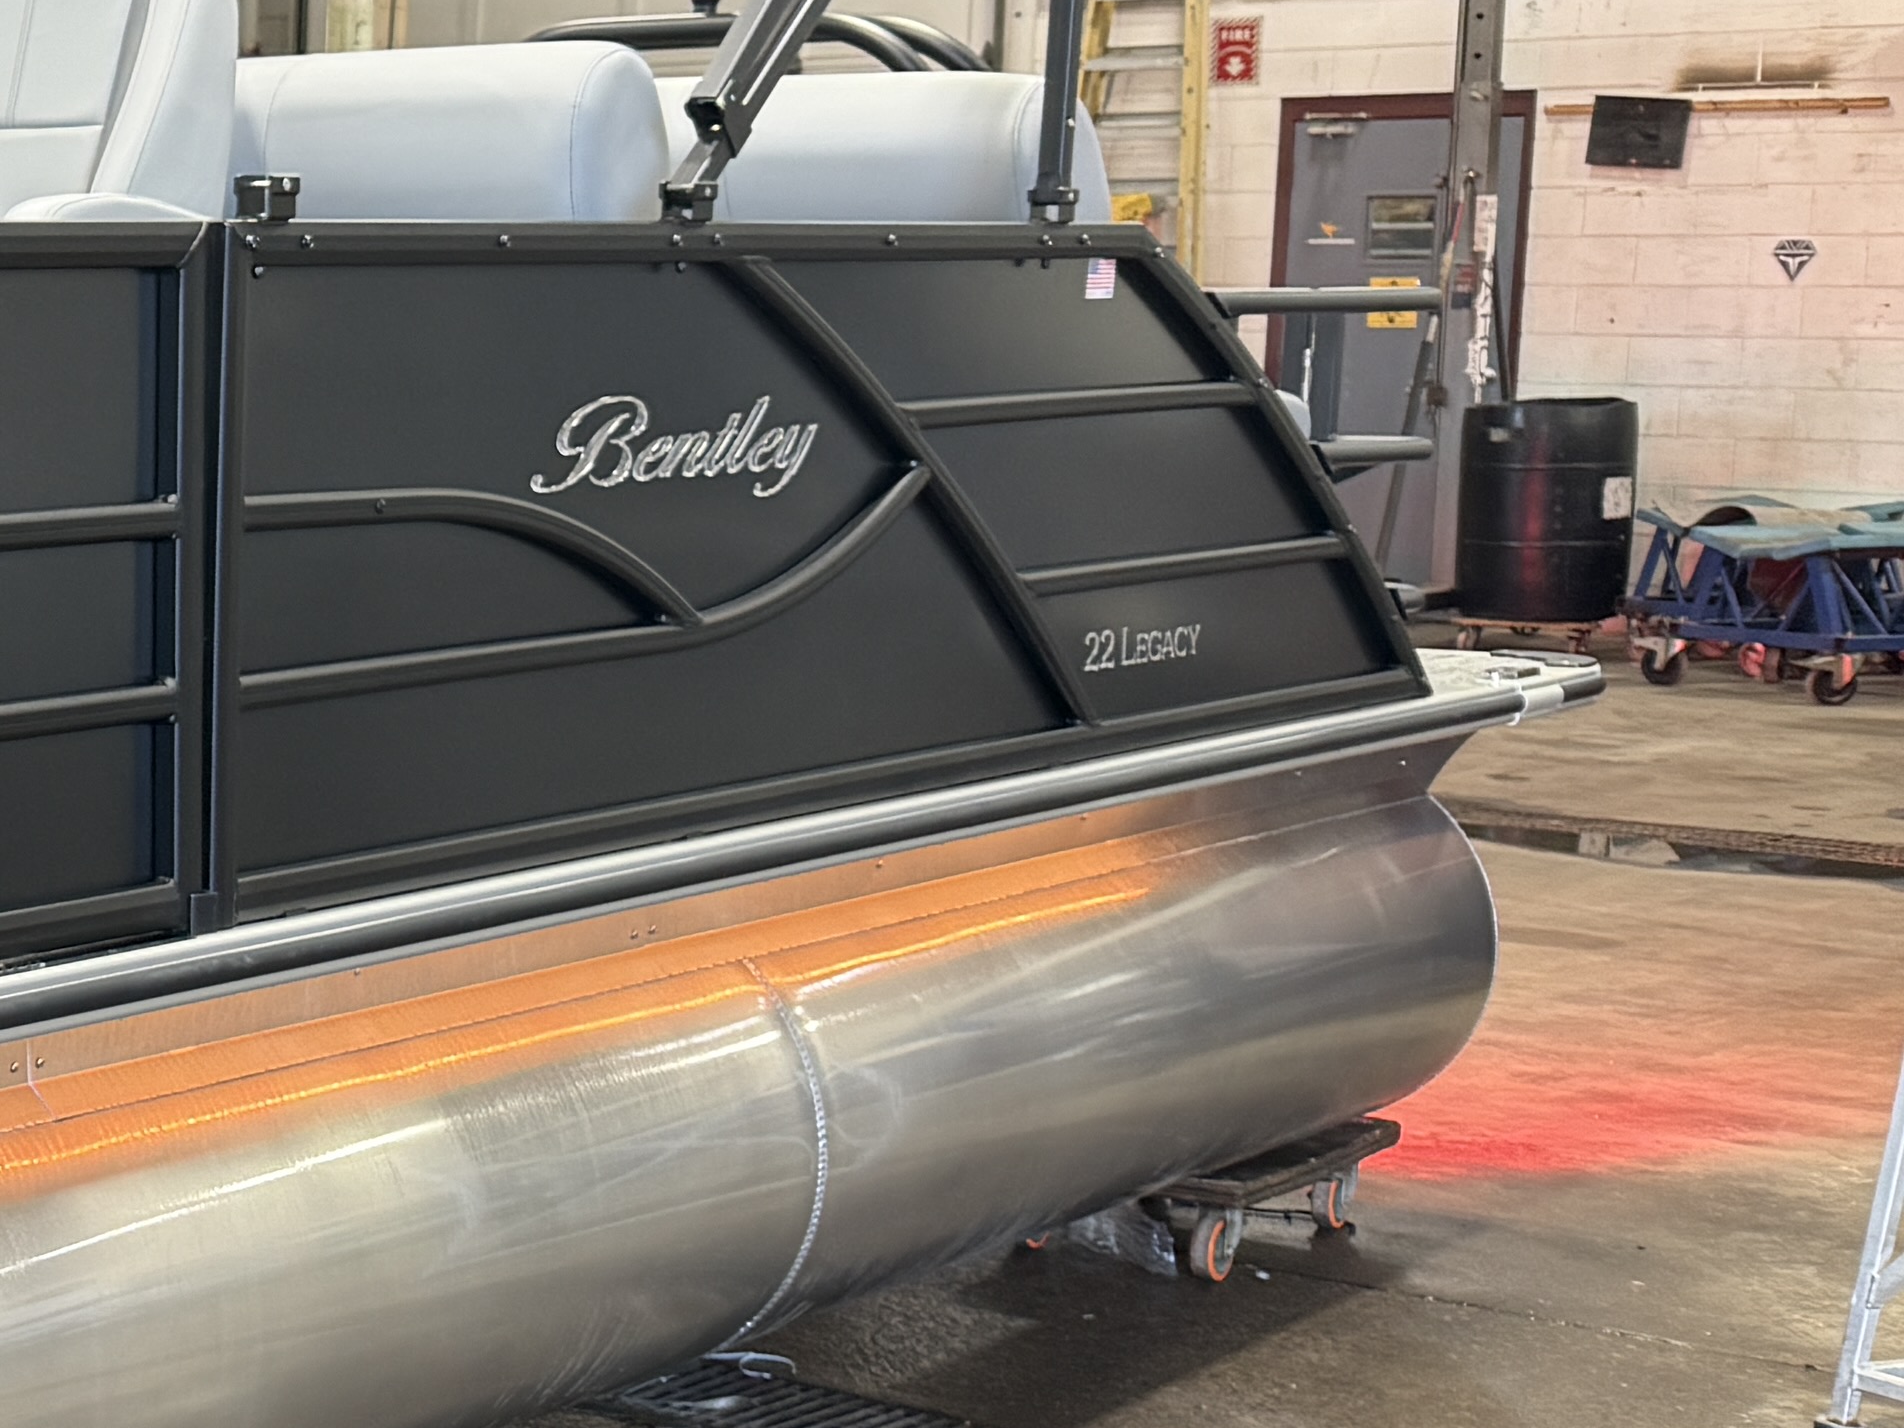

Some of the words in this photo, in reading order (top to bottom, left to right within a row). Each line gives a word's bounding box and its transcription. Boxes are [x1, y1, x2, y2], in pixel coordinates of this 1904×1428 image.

[530, 394, 818, 498] Bentley
[1084, 629, 1115, 672] 22
[1121, 624, 1201, 666] LEGACY
